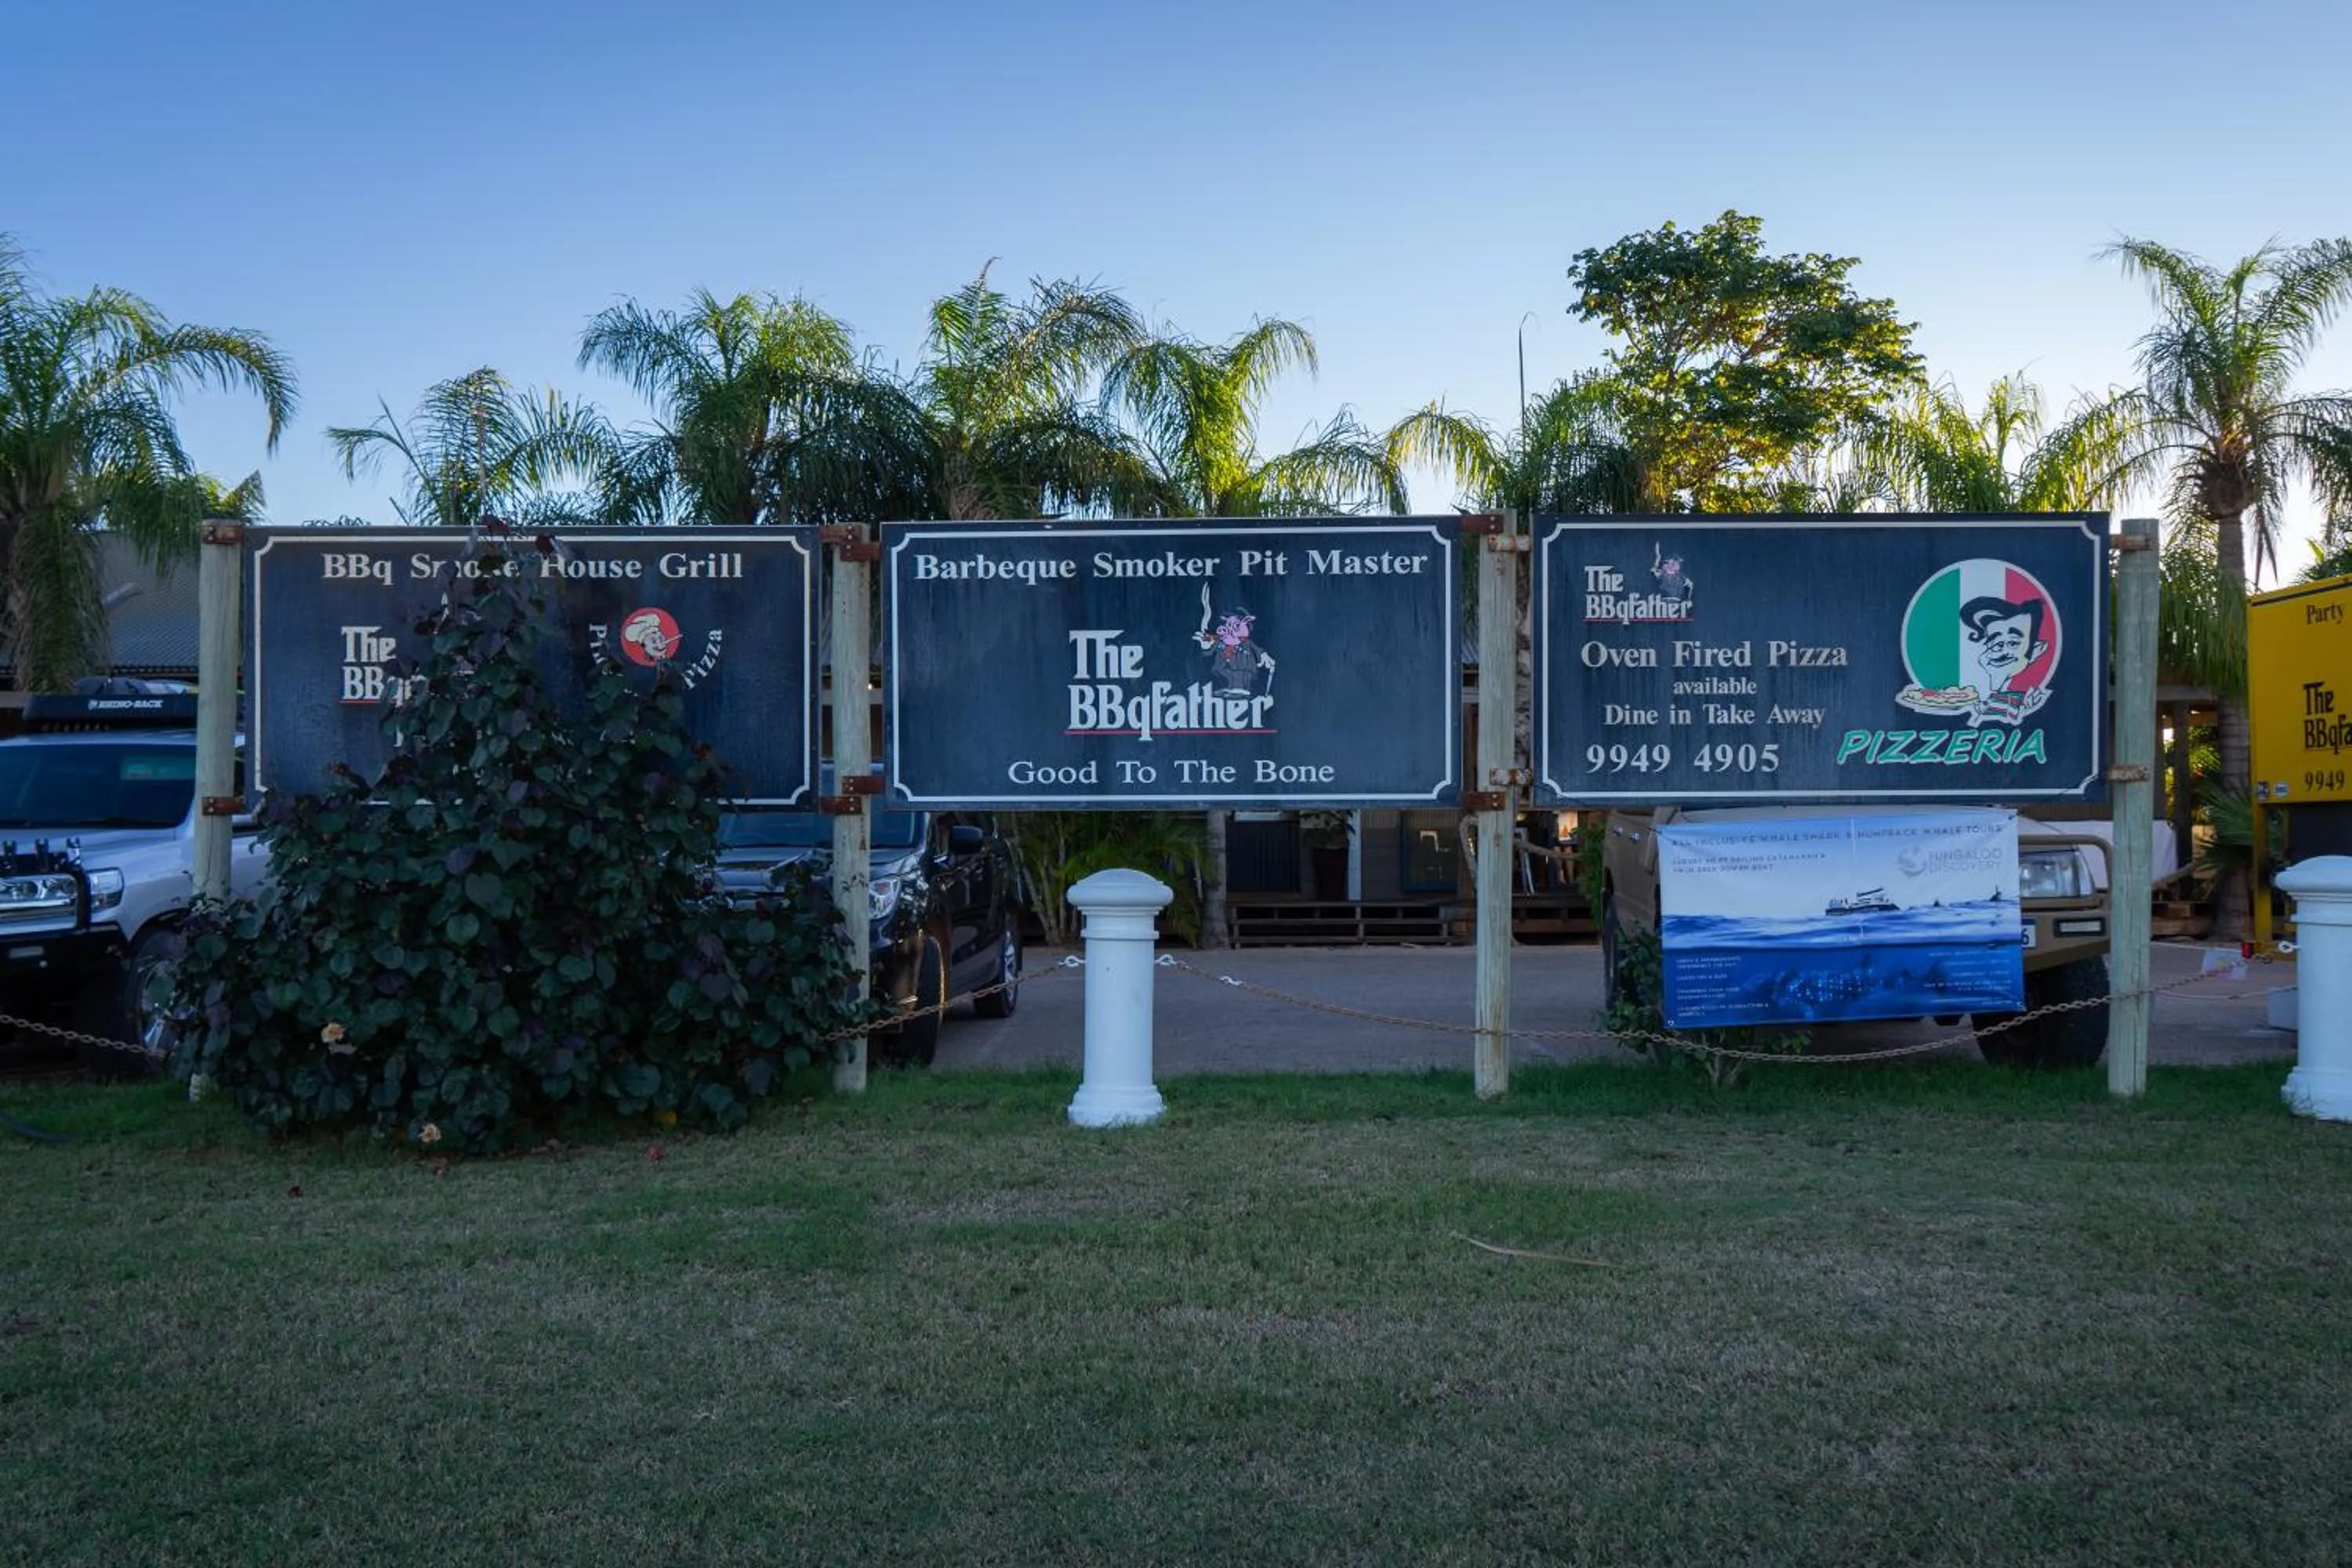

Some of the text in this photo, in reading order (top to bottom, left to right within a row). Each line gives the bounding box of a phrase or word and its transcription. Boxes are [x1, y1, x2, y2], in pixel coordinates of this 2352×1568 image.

[322, 552, 743, 586] BBq Soe House Grill
[914, 549, 1428, 586] Barbeque Smoker Pit Master
[1584, 565, 1624, 592] The
[1584, 592, 1693, 625] BBqfather
[2307, 603, 2345, 625] Party
[341, 626, 397, 662] The
[683, 628, 723, 690] Pizza
[1069, 630, 1144, 680] The
[1581, 640, 1849, 668] Oven Fired Pizza
[1673, 677, 1758, 695] available
[2303, 681, 2335, 716] The
[1067, 681, 1274, 742] BBqfather
[1605, 703, 1826, 729] Dine in Take Away
[1586, 743, 1780, 773] 9949 4905
[1836, 728, 2047, 765] PIZZERIA
[1007, 760, 1335, 784] Good To The Bone
[2304, 770, 2345, 793] 9949
